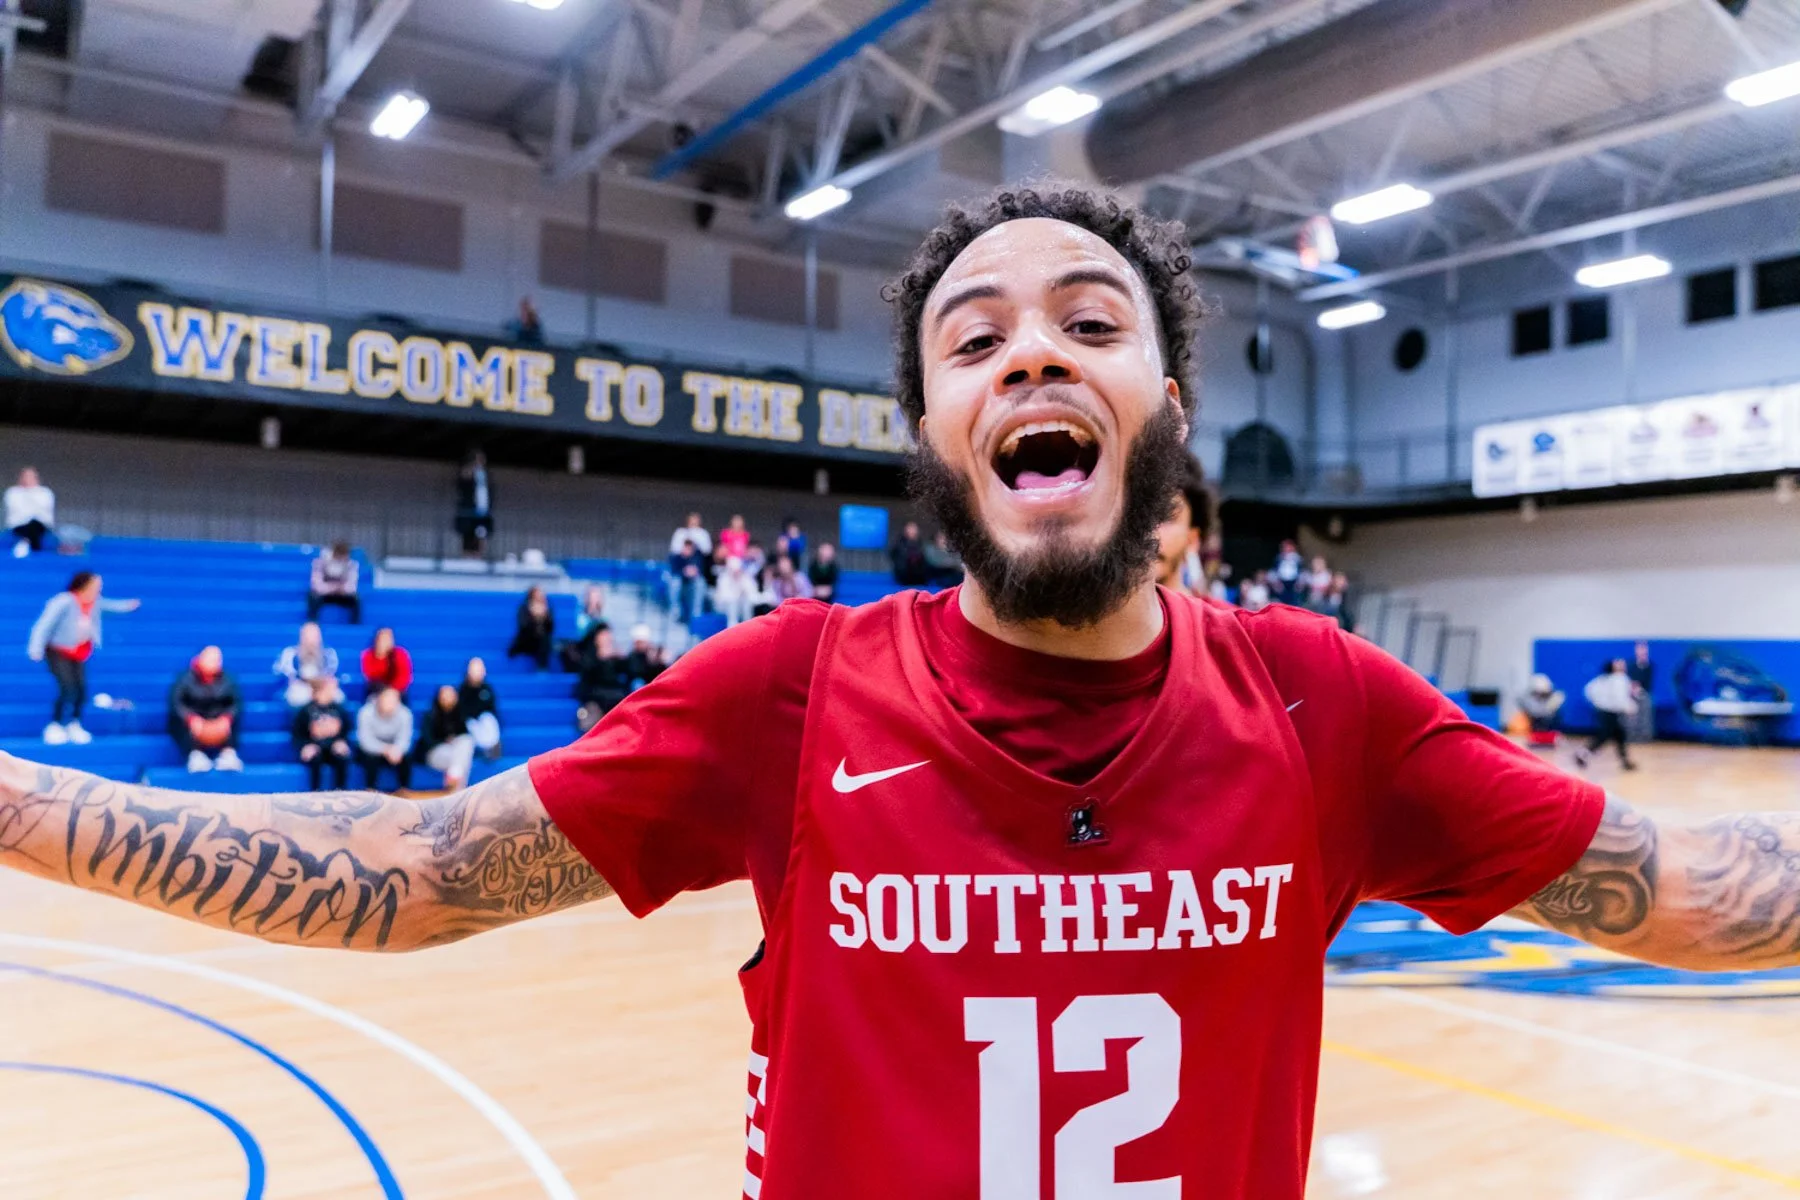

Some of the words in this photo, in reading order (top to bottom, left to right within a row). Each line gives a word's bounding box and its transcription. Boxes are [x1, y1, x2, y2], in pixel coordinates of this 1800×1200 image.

[138, 301, 555, 416] WELCOME
[575, 357, 665, 427] TO
[683, 371, 804, 442] THE
[828, 862, 1294, 954] SOUTHEAST
[963, 992, 1182, 1200] 12
